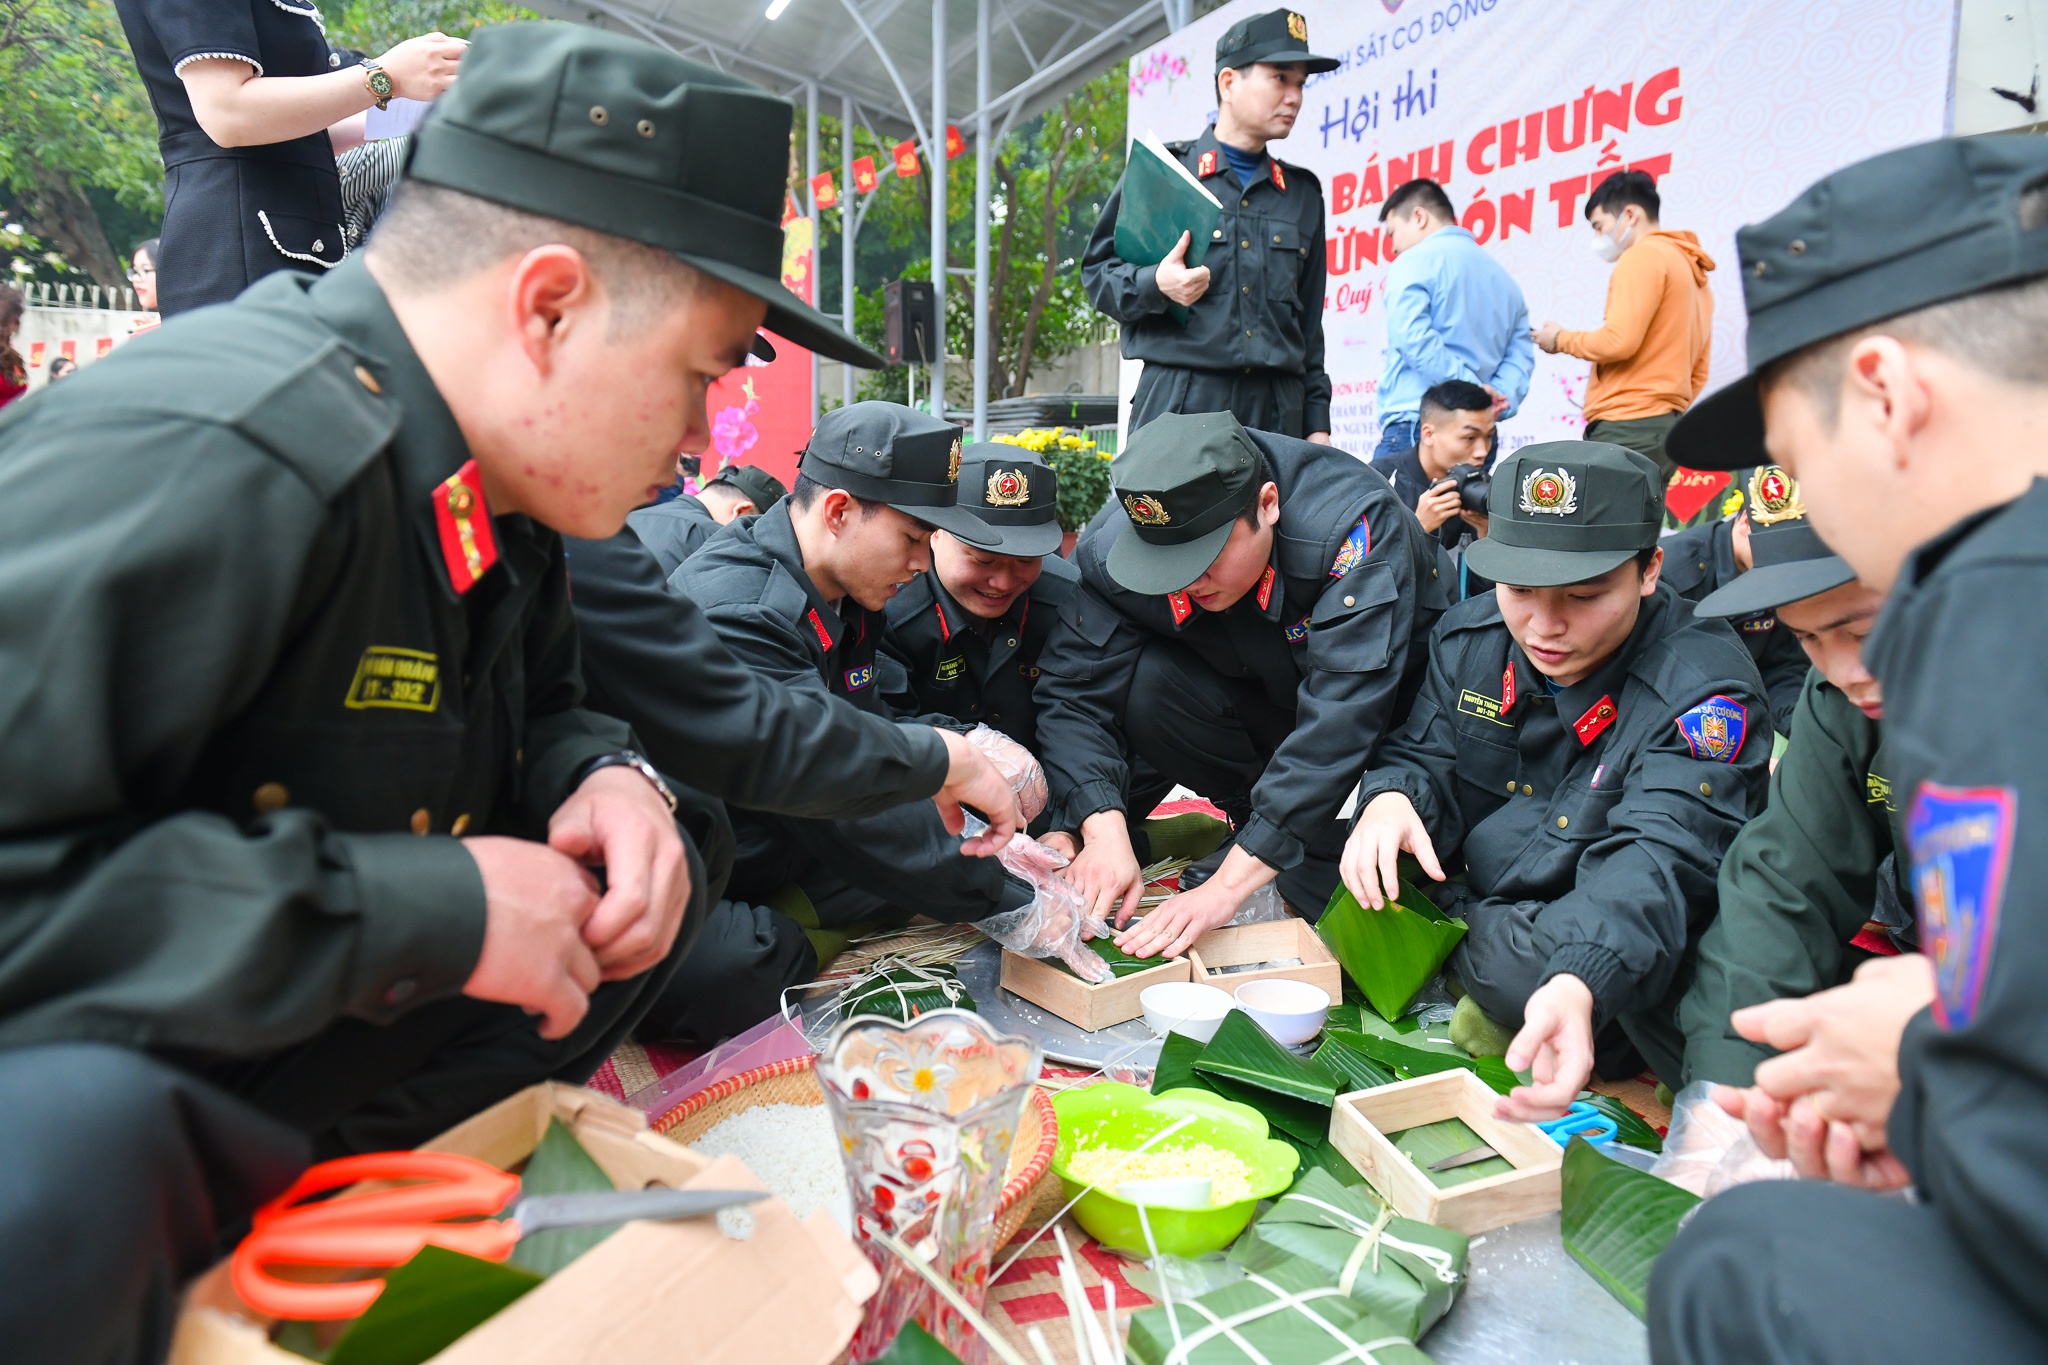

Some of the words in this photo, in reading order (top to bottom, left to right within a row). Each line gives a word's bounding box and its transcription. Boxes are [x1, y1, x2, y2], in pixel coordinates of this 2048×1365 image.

[1356, 33, 1386, 67] SÁT
[1392, 17, 1424, 50] CƠ
[1319, 91, 1379, 149] Hội
[1393, 68, 1438, 121] thi
[1331, 139, 1454, 216] BÁNH
[1466, 66, 1684, 175] CHƯNG
[1454, 186, 1536, 246] ÓN
[1336, 281, 1373, 314] Quý
